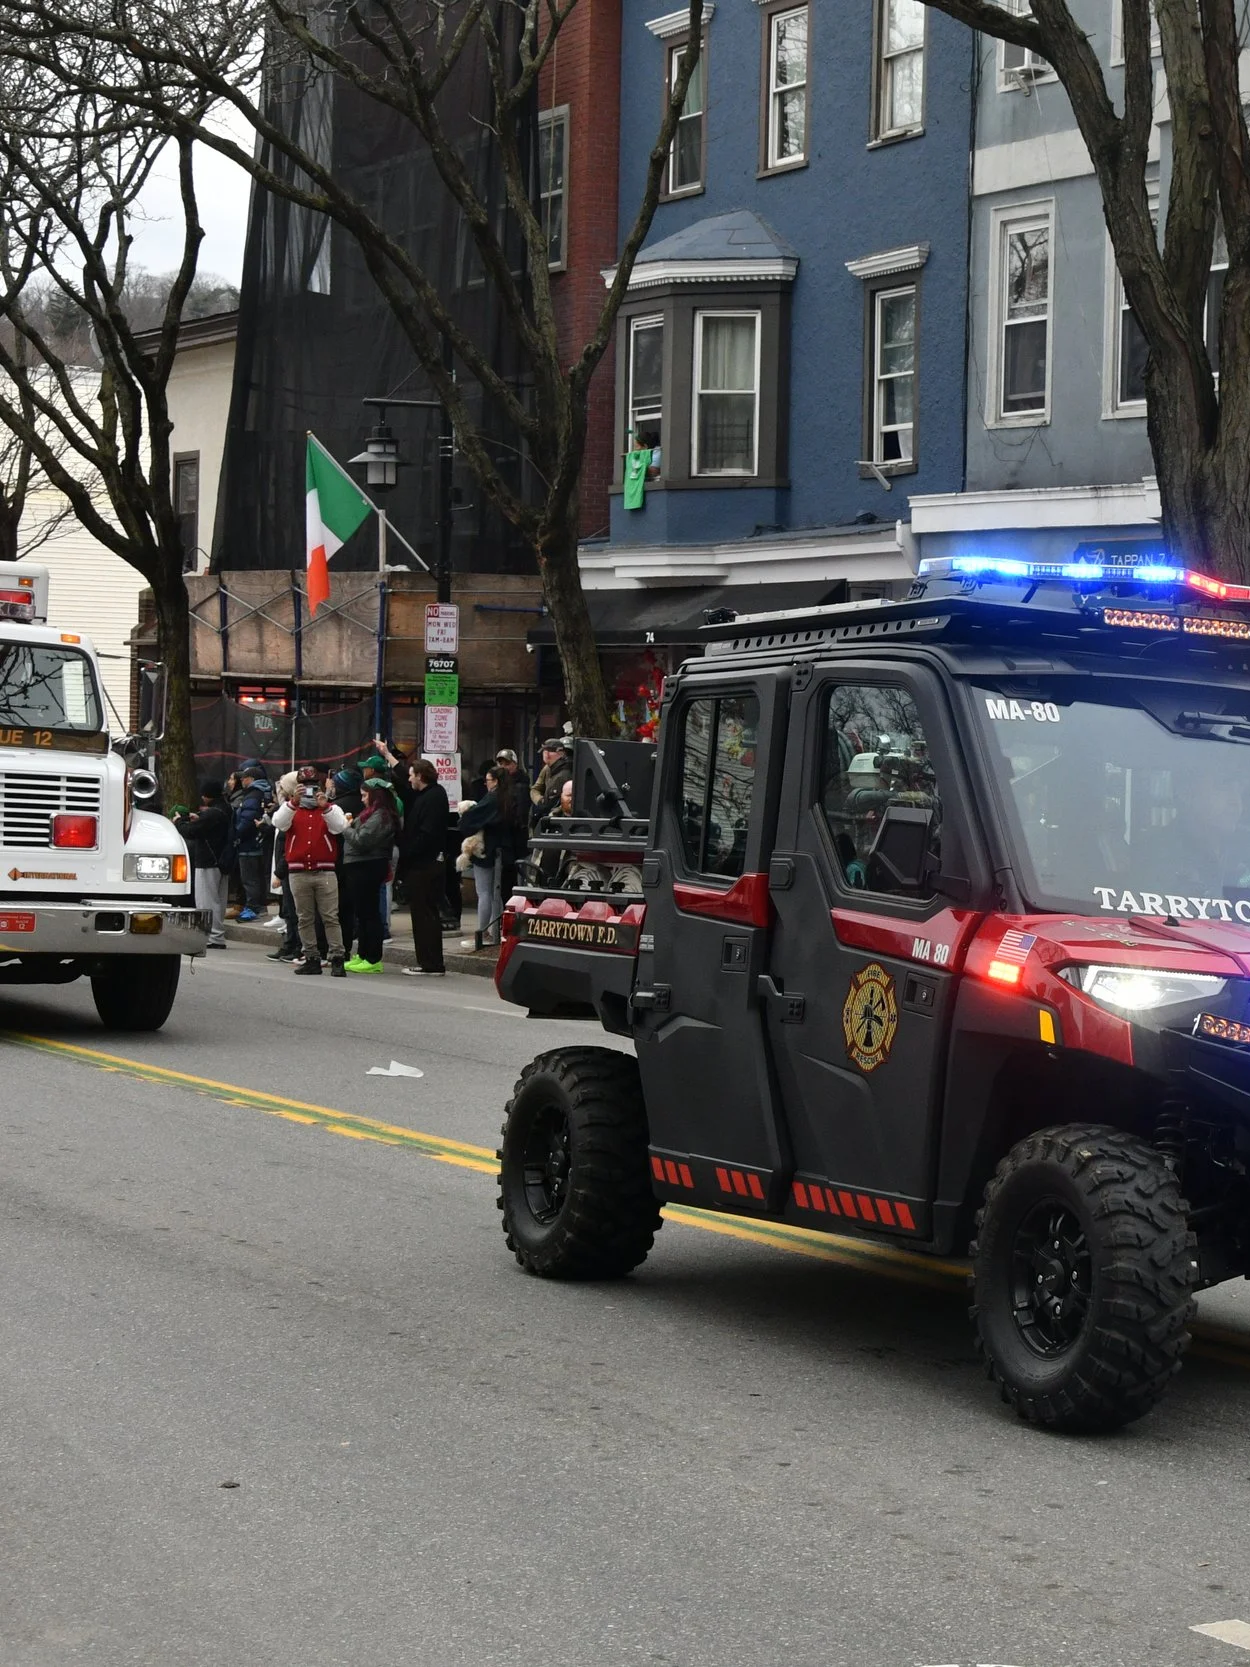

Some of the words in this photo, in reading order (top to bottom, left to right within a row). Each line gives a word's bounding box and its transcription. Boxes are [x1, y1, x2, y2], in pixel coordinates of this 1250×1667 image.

[1111, 554, 1154, 567] TAPPAN
[428, 606, 439, 616] NO
[646, 632, 655, 643] 74
[985, 699, 1060, 722] MA-80
[32, 731, 52, 746] 12
[528, 918, 594, 942] TARRYTOWN
[597, 924, 618, 944] F.D.
[912, 938, 930, 960] MA
[934, 944, 949, 964] 80
[868, 970, 880, 979] FIRE
[856, 1052, 880, 1064] RESCUE
